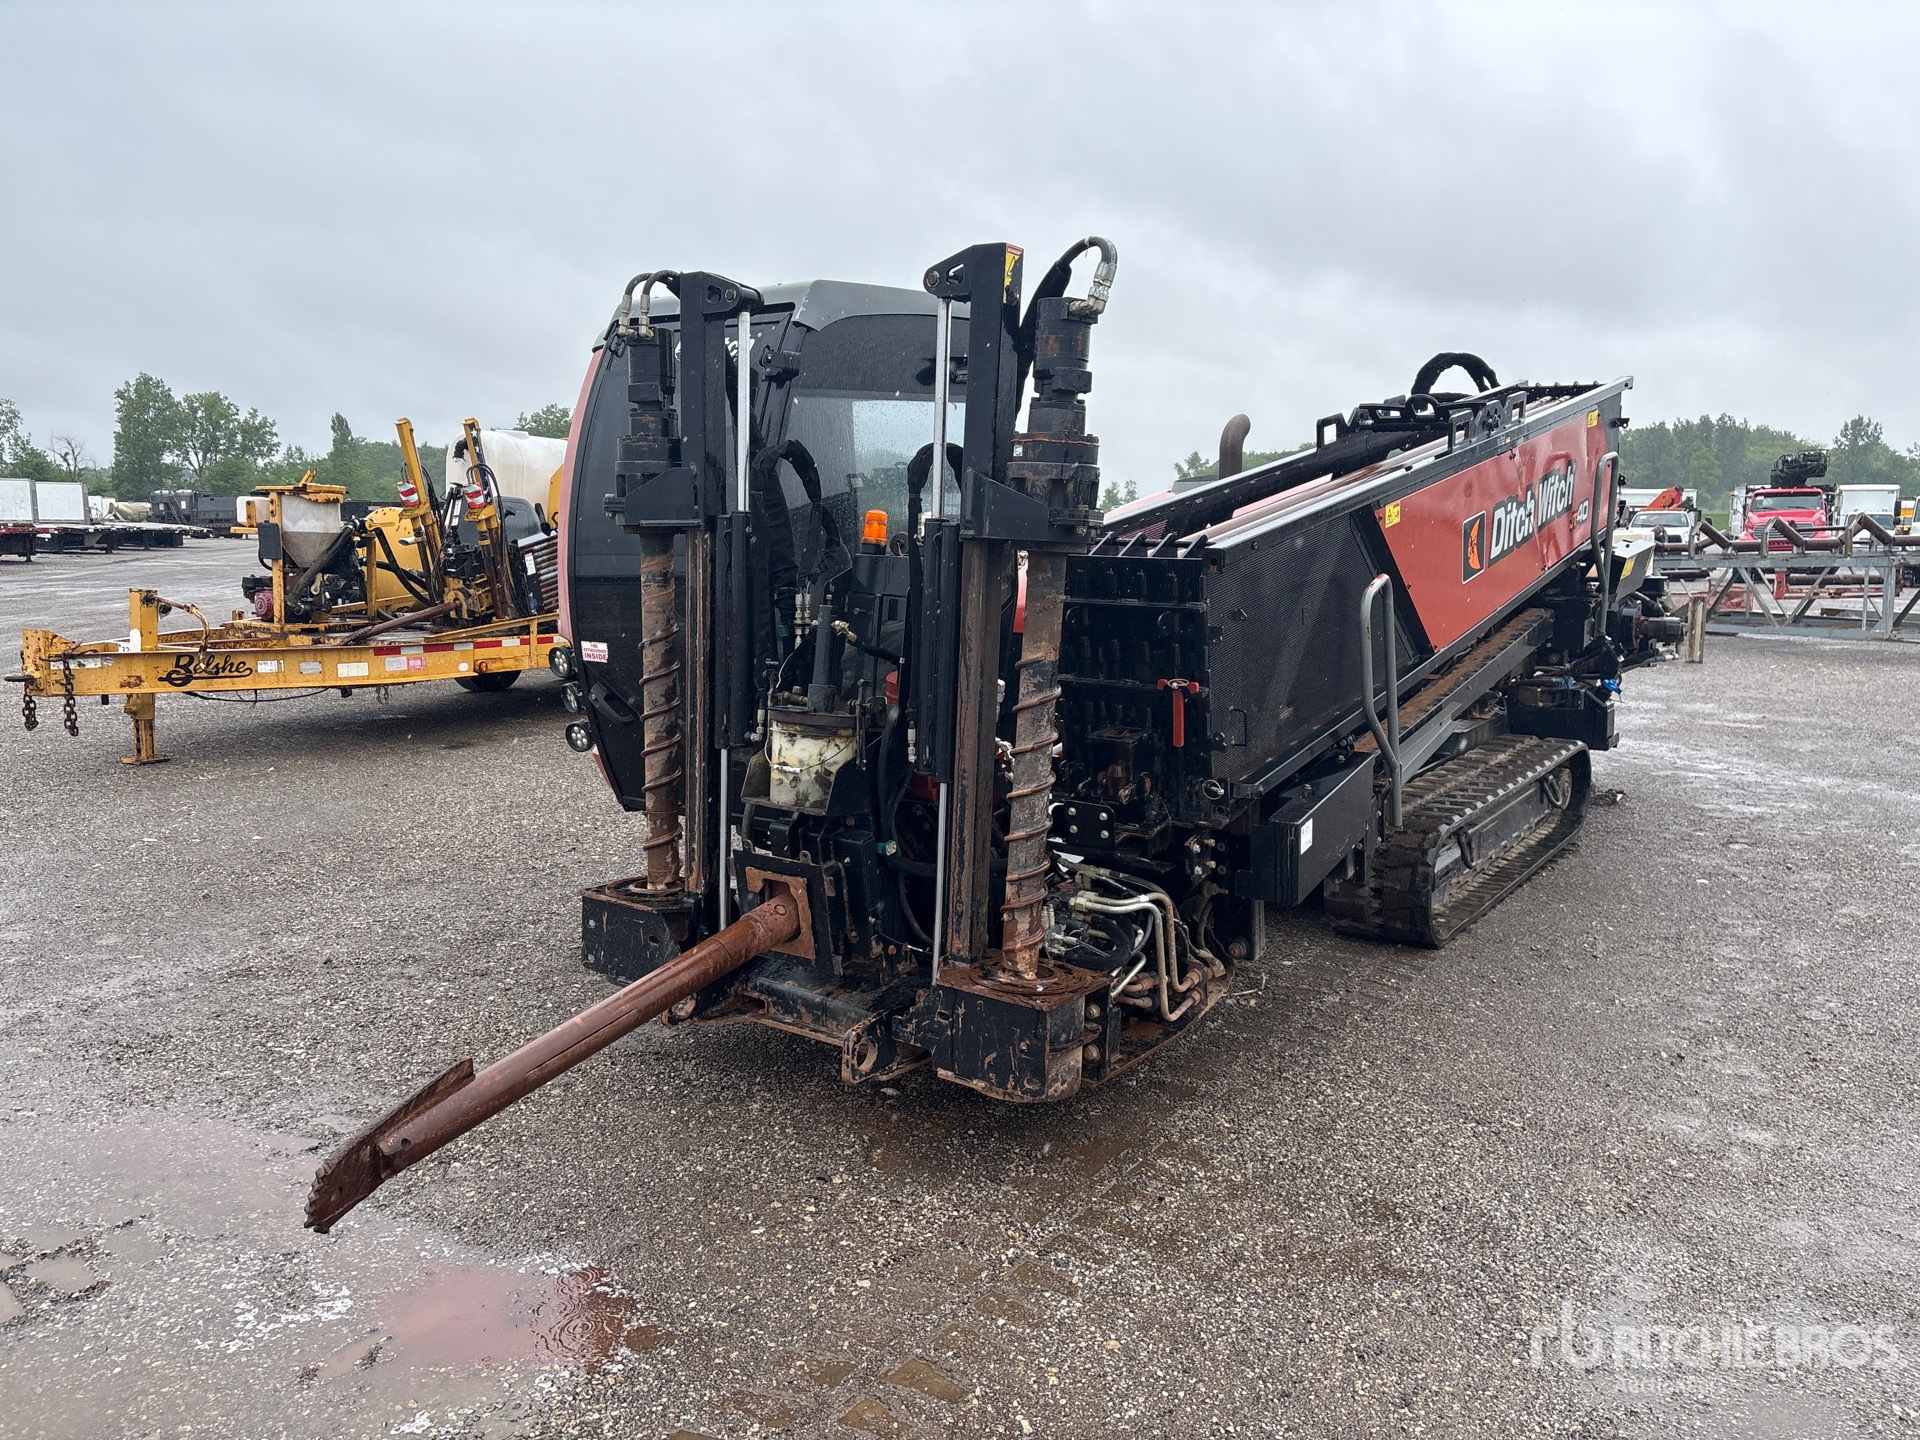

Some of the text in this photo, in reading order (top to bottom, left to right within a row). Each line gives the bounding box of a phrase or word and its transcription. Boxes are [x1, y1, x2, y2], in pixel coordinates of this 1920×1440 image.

[1490, 465, 1574, 560] Ditch Witch
[158, 654, 253, 687] Belshe
[584, 652, 607, 660] INSIDE
